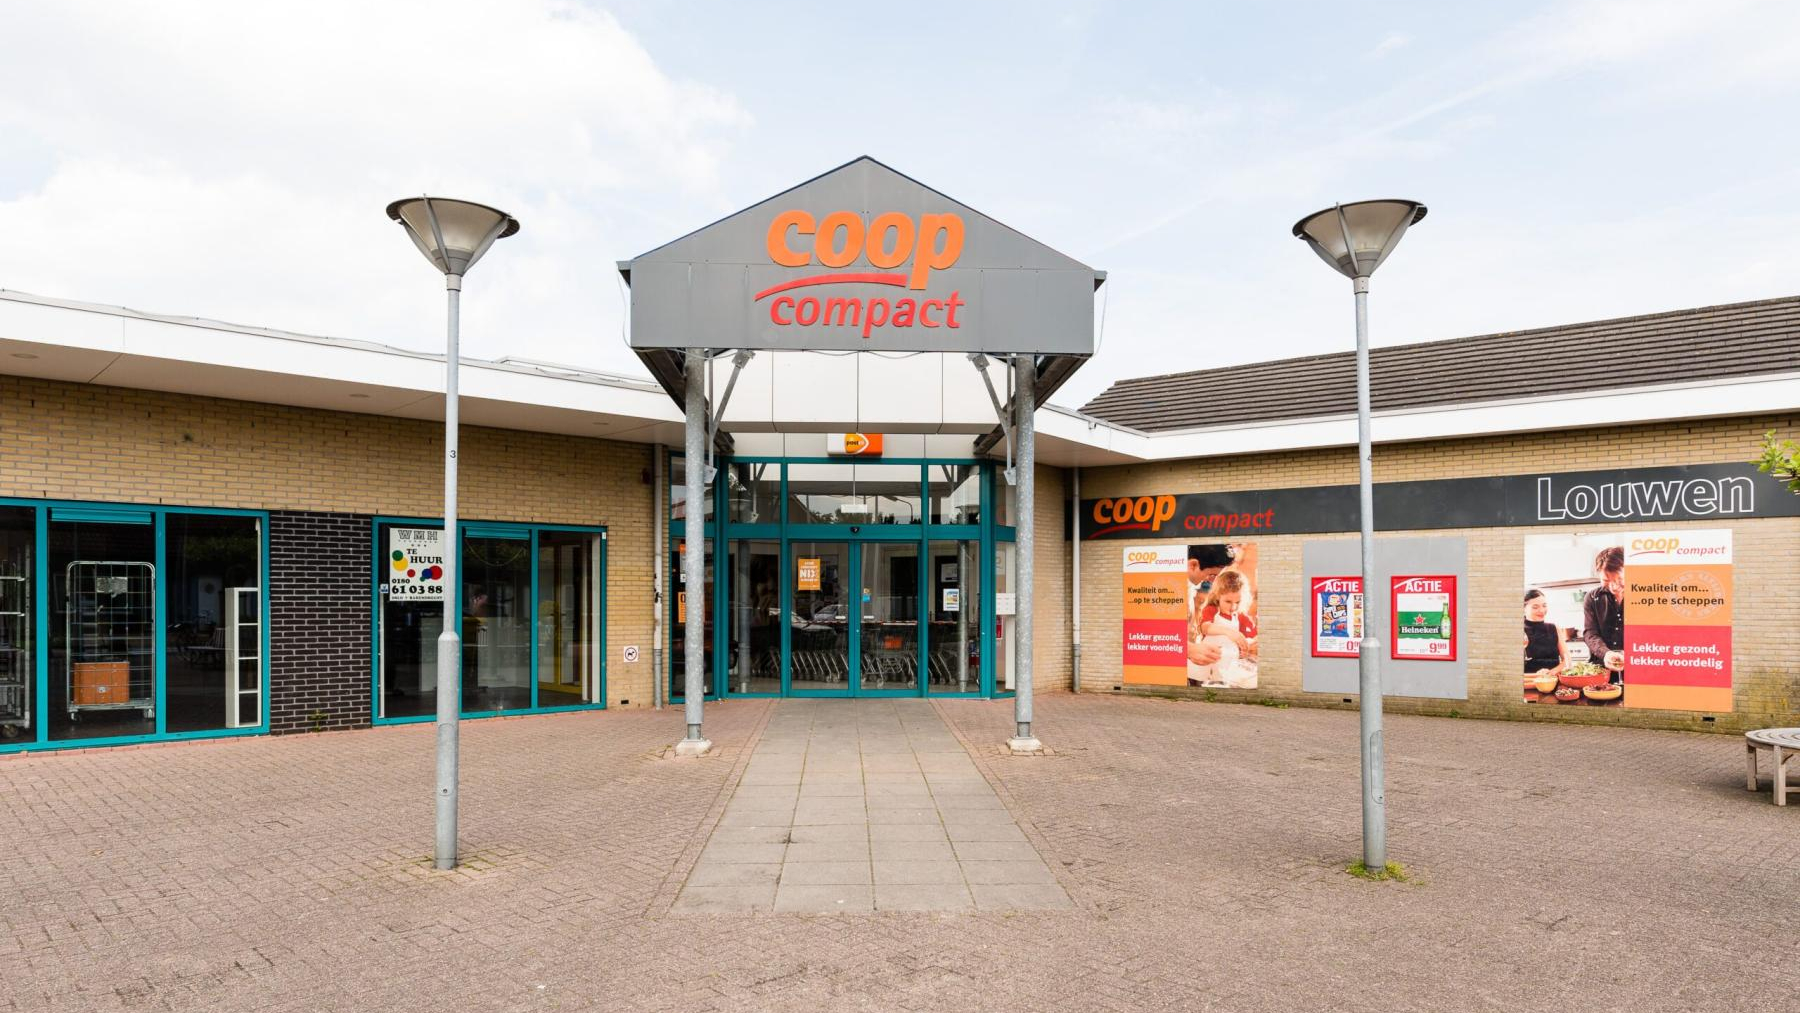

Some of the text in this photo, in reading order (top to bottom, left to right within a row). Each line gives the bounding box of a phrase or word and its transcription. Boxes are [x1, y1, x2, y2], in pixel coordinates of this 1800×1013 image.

[767, 210, 965, 290] coop
[770, 290, 965, 338] compact
[450, 450, 456, 459] 3
[1537, 476, 1754, 521] Louwen
[1093, 494, 1275, 534] coop compact
[1631, 537, 1680, 553] coop
[1676, 545, 1726, 556] compact
[410, 556, 443, 564] HUUR
[1128, 551, 1157, 564] coop
[1155, 558, 1185, 566] compact
[391, 585, 407, 594] 61
[409, 585, 426, 594] 03
[427, 585, 443, 594] 88
[1324, 581, 1359, 592] ACTIE
[1404, 580, 1442, 592] ACTIE
[1631, 583, 1709, 593] Kwaliteit om...
[1151, 597, 1184, 605] scheppen
[1631, 596, 1725, 607] ...op te scheppen
[1401, 626, 1439, 634] Heineken
[1128, 633, 1182, 643] Lekker gezond,
[1127, 643, 1183, 654] lekker voordelig
[1632, 643, 1720, 656] Lekker gezond,
[1630, 656, 1724, 670] lekker voordelig
